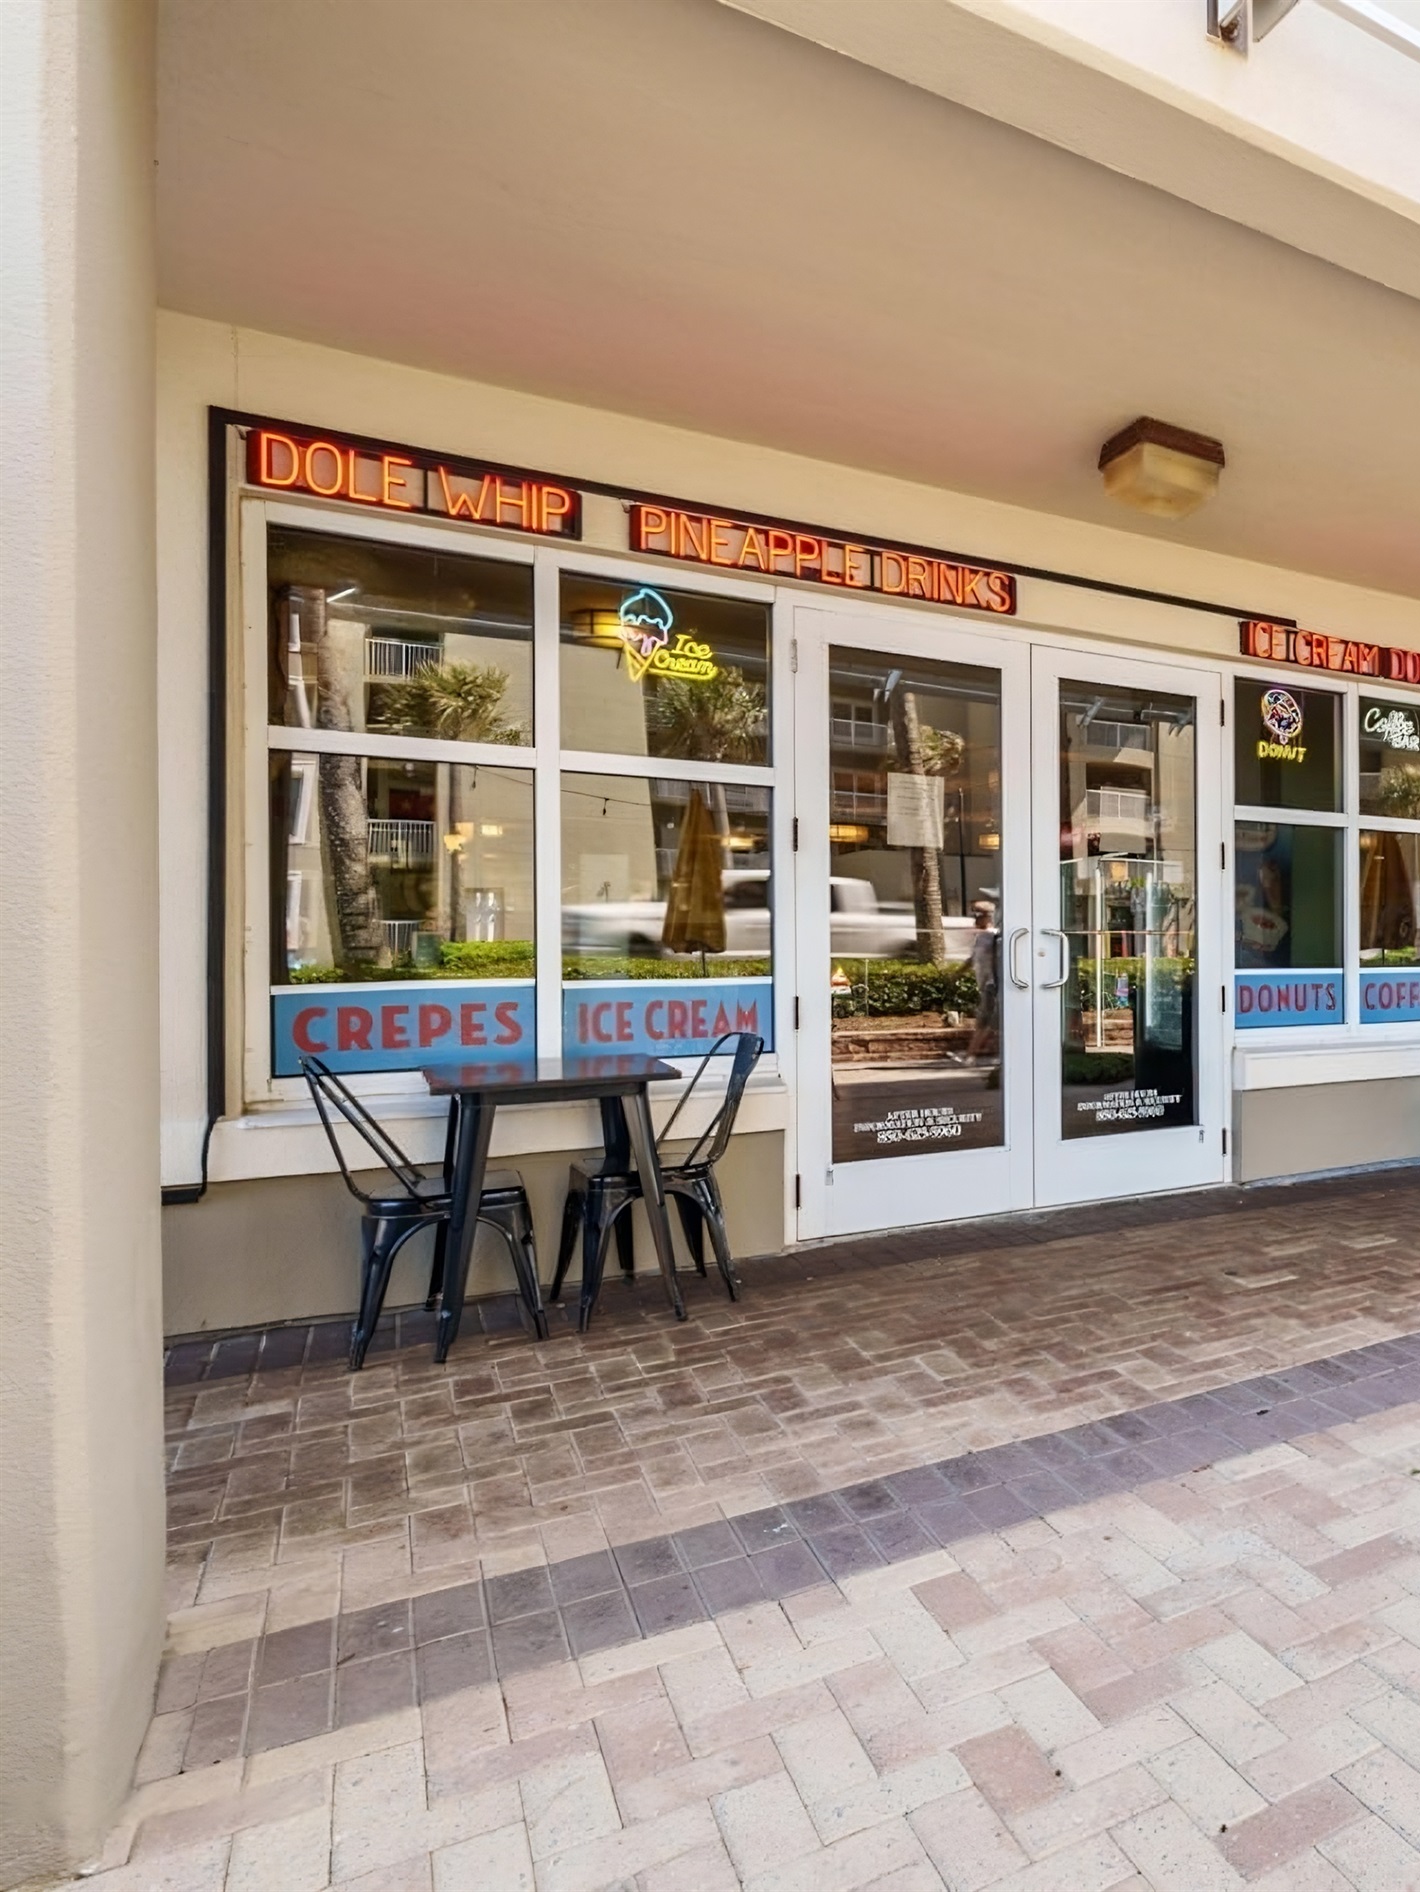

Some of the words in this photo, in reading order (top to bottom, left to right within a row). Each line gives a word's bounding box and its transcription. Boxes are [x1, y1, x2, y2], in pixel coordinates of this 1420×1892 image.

[259, 432, 413, 508] DOLE
[437, 465, 571, 532] WHIP
[639, 505, 866, 588] PINEAPPLE
[880, 550, 1012, 614] DRINKS
[653, 649, 718, 675] Cream
[669, 634, 714, 659] Ice
[1248, 621, 1287, 661] ICE
[1294, 630, 1380, 676] CREAM
[1257, 740, 1306, 762] DONUT
[578, 1001, 635, 1045] ICE
[644, 997, 759, 1040] CREAM
[1238, 982, 1337, 1014] DONUTS
[291, 1001, 523, 1054] CREPES
